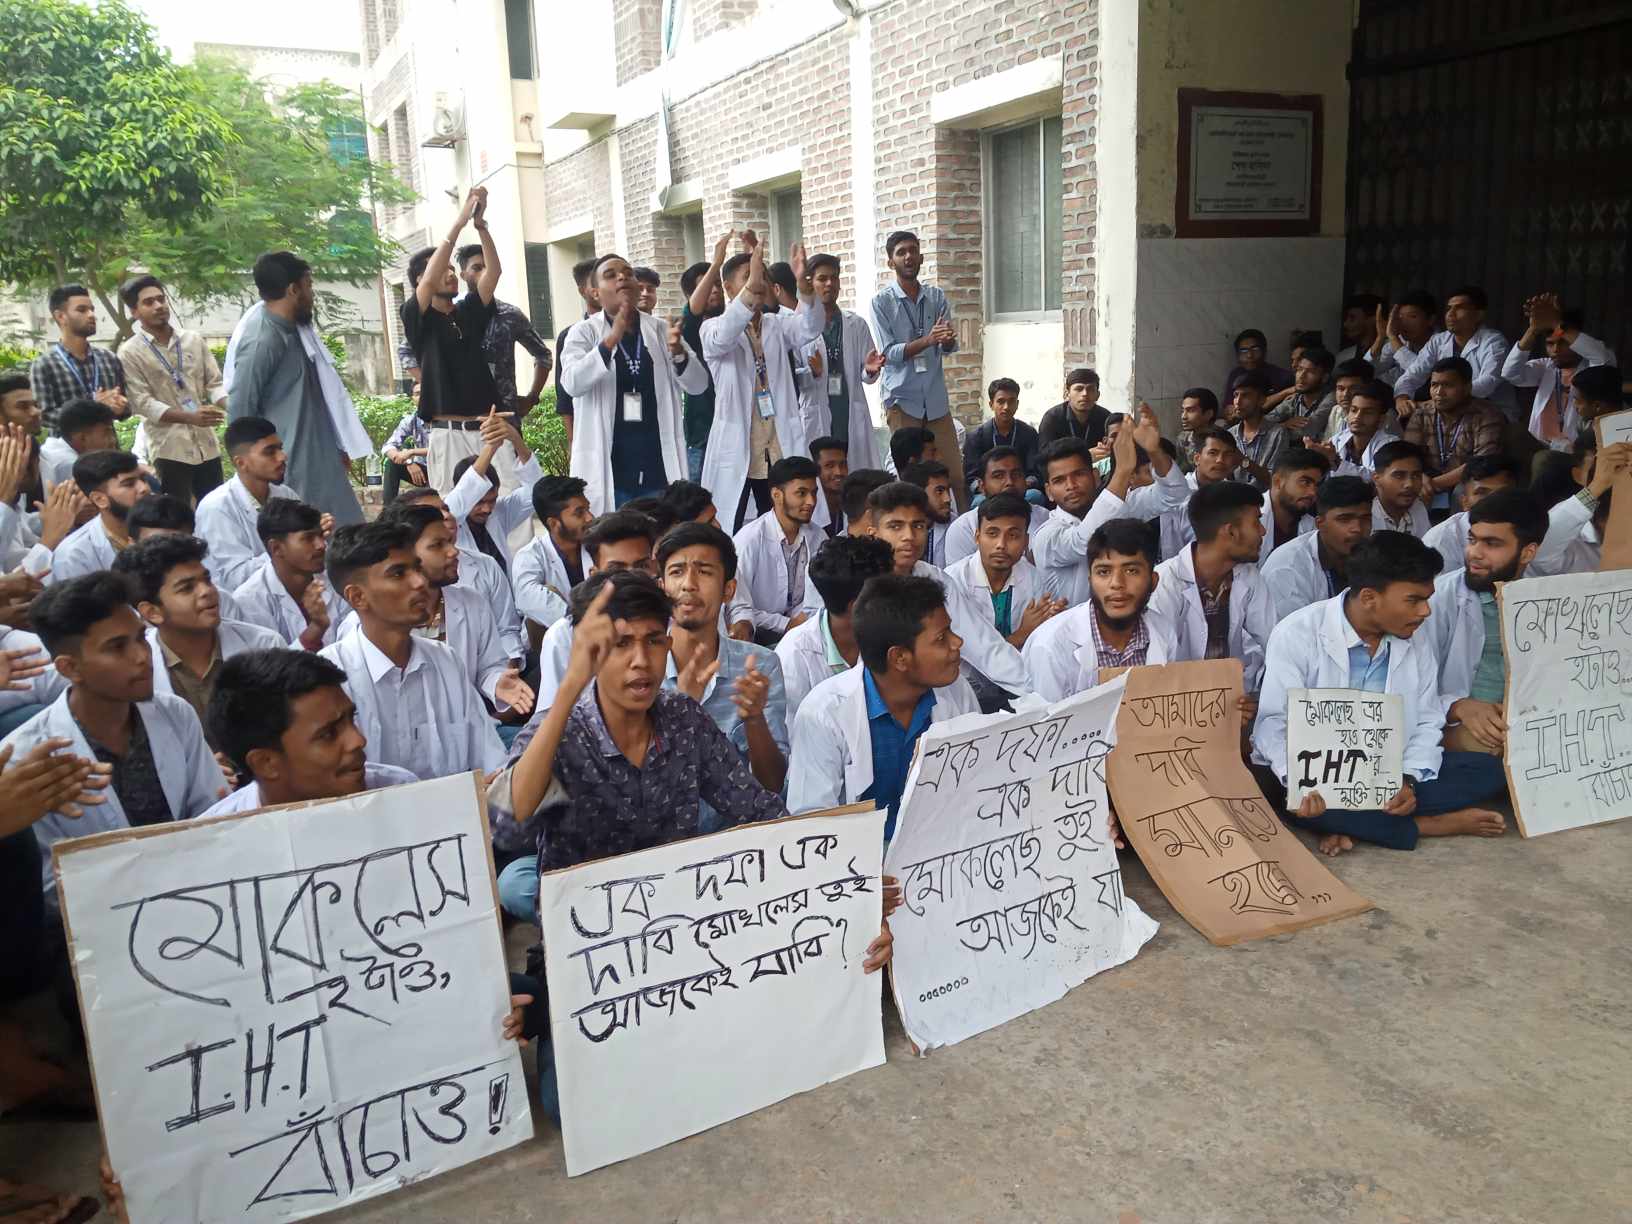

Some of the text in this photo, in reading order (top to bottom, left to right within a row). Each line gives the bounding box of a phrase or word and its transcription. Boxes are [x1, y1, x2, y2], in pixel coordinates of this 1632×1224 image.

[1130, 687, 1232, 729] আমাদের
[1361, 701, 1384, 723] এর
[916, 735, 989, 794] এক
[1135, 736, 1209, 788] দাবি
[1361, 728, 1393, 749] থেকে
[977, 778, 1031, 827] এক
[1333, 781, 1370, 808] মুক্তি
[1136, 796, 1278, 858] মানতে
[571, 834, 838, 939] এক দফা এক
[902, 799, 1105, 917] মোকলেছ তুই
[111, 833, 470, 1007] মোকলেস
[567, 856, 880, 995] দাবি মোখলেস তুই
[956, 875, 1089, 960] আজকেই
[571, 950, 739, 1042] আজকেই
